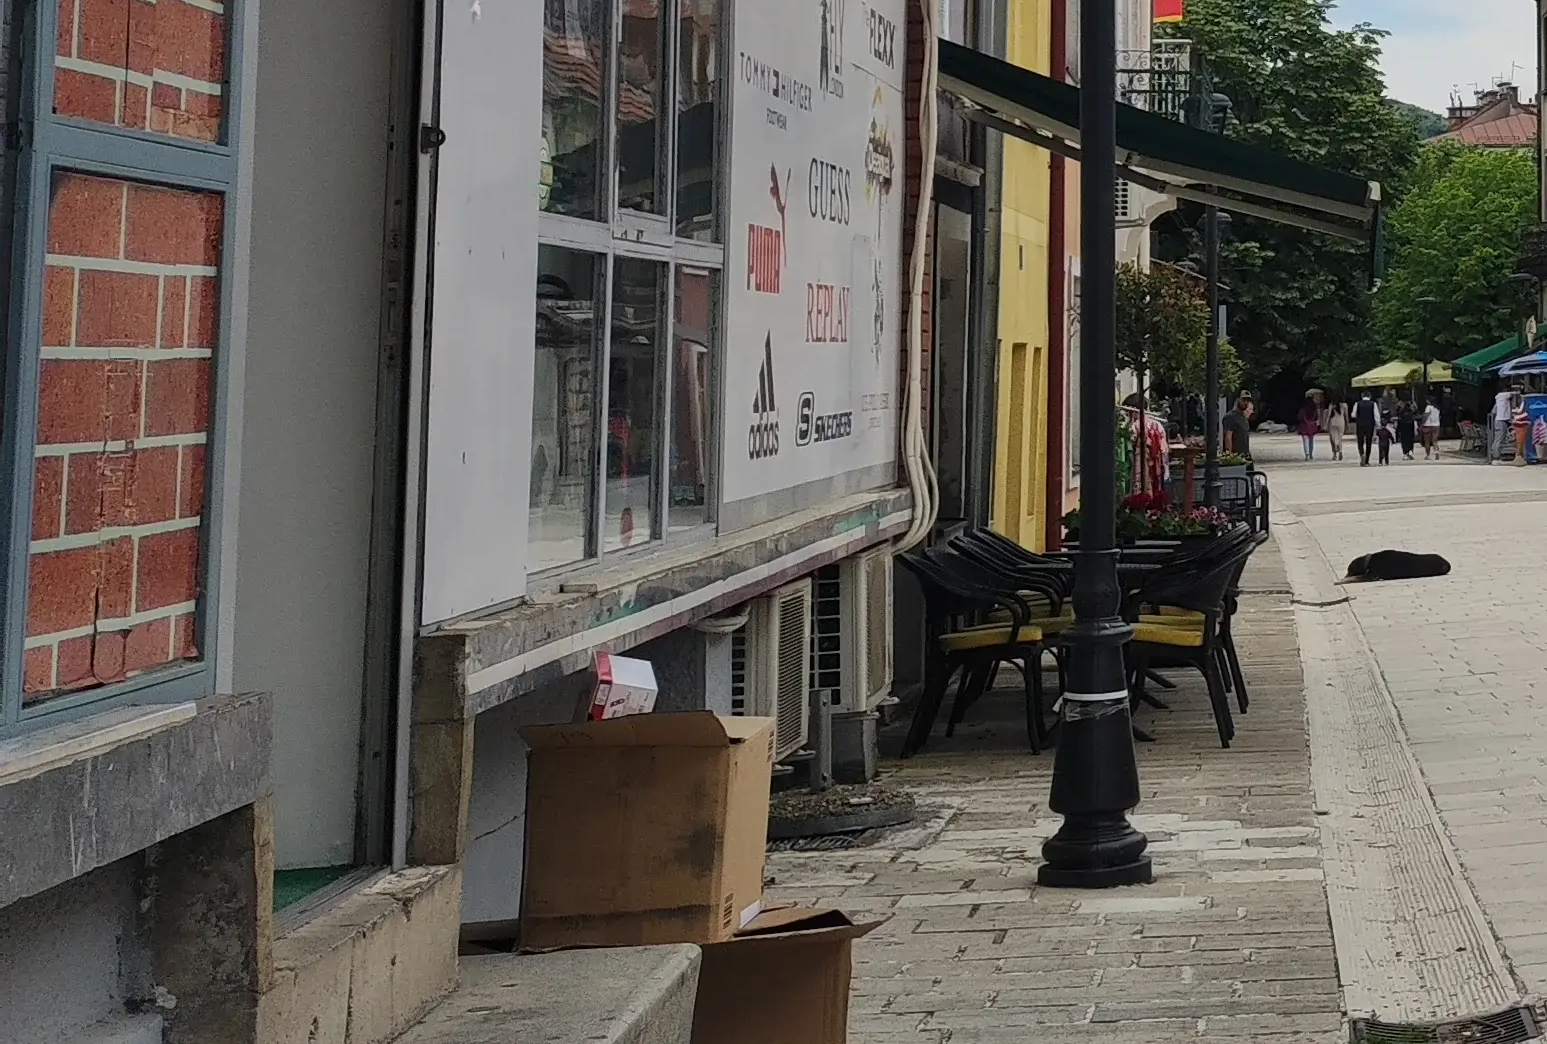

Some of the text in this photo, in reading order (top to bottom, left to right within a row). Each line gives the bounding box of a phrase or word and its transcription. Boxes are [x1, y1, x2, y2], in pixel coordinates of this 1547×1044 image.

[869, 7, 896, 70] FLEXX
[740, 51, 812, 113] TOMMY HILFIGER
[808, 157, 851, 226] GUESS
[747, 224, 782, 295] PUMA
[748, 411, 780, 461] adidas
[814, 411, 853, 443] SKECHERS
